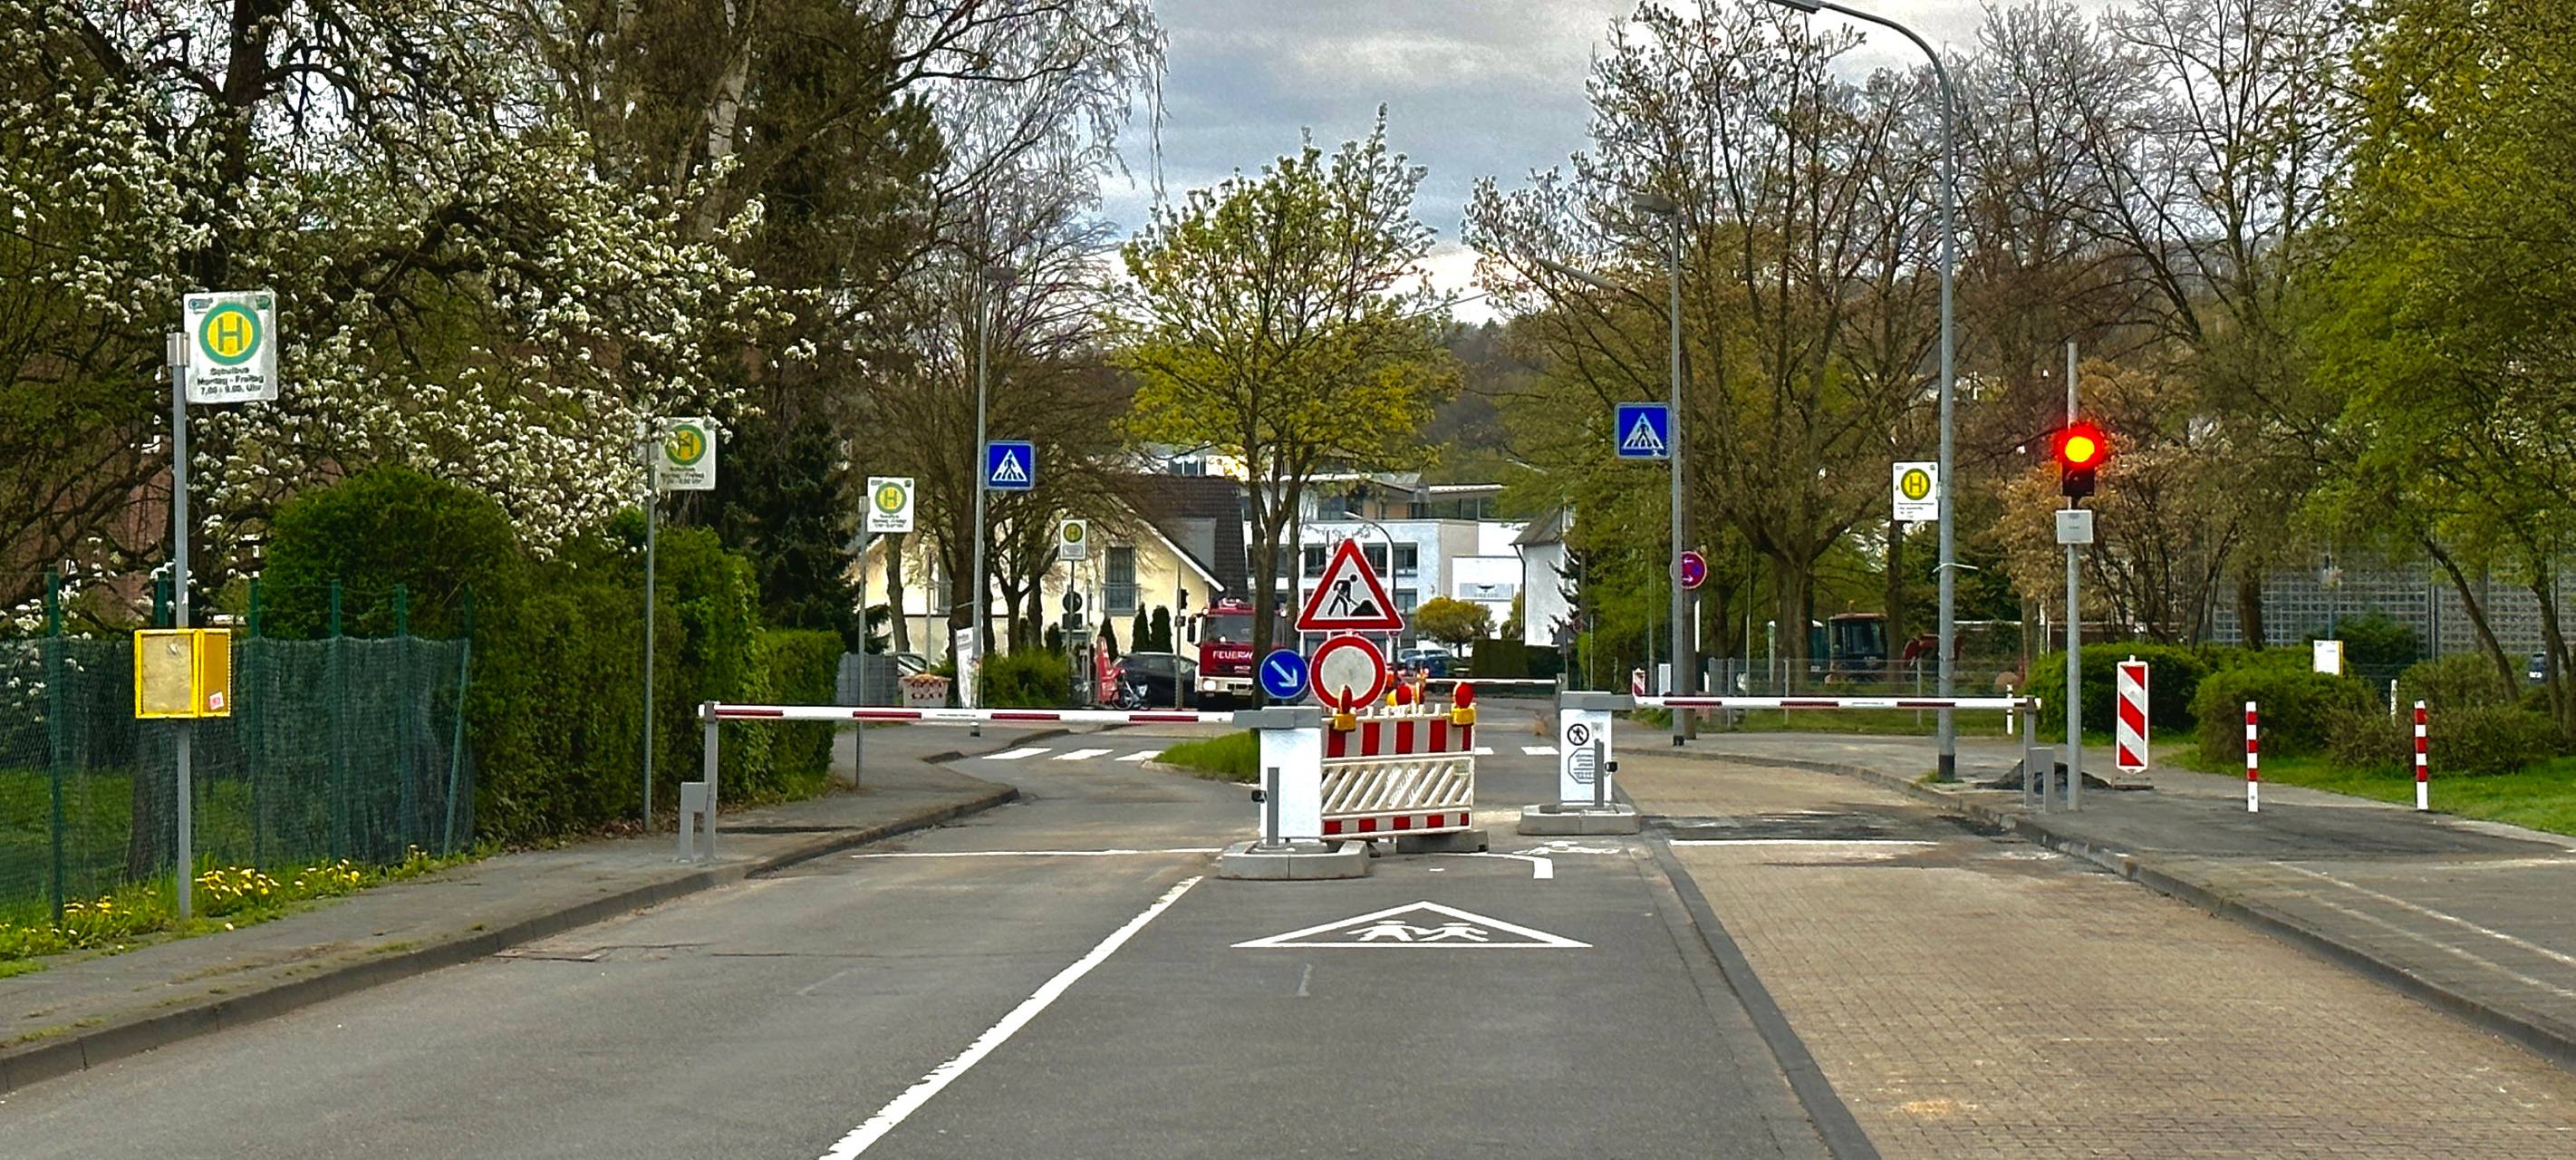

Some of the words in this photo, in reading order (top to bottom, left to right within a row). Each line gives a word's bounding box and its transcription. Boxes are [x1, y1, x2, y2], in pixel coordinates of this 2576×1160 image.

[217, 315, 243, 353] H
[1909, 476, 1923, 494] H
[883, 489, 898, 508] H
[1212, 650, 1254, 660] FEUERW
